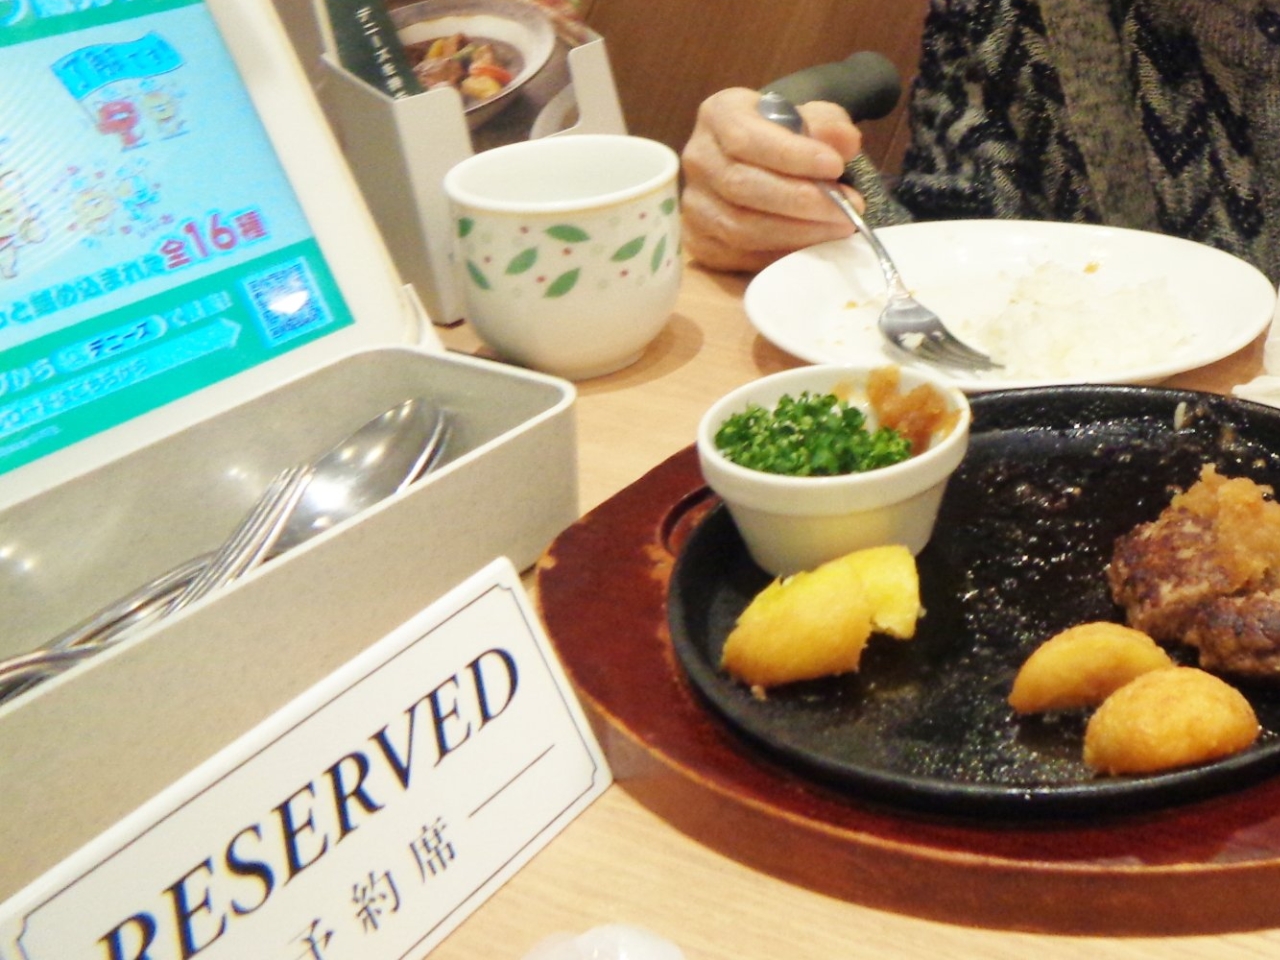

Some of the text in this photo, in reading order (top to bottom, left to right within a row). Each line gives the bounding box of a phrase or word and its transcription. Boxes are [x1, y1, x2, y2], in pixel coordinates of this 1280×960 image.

[88, 321, 152, 358] デニーズ
[96, 648, 519, 960] RESERVED
